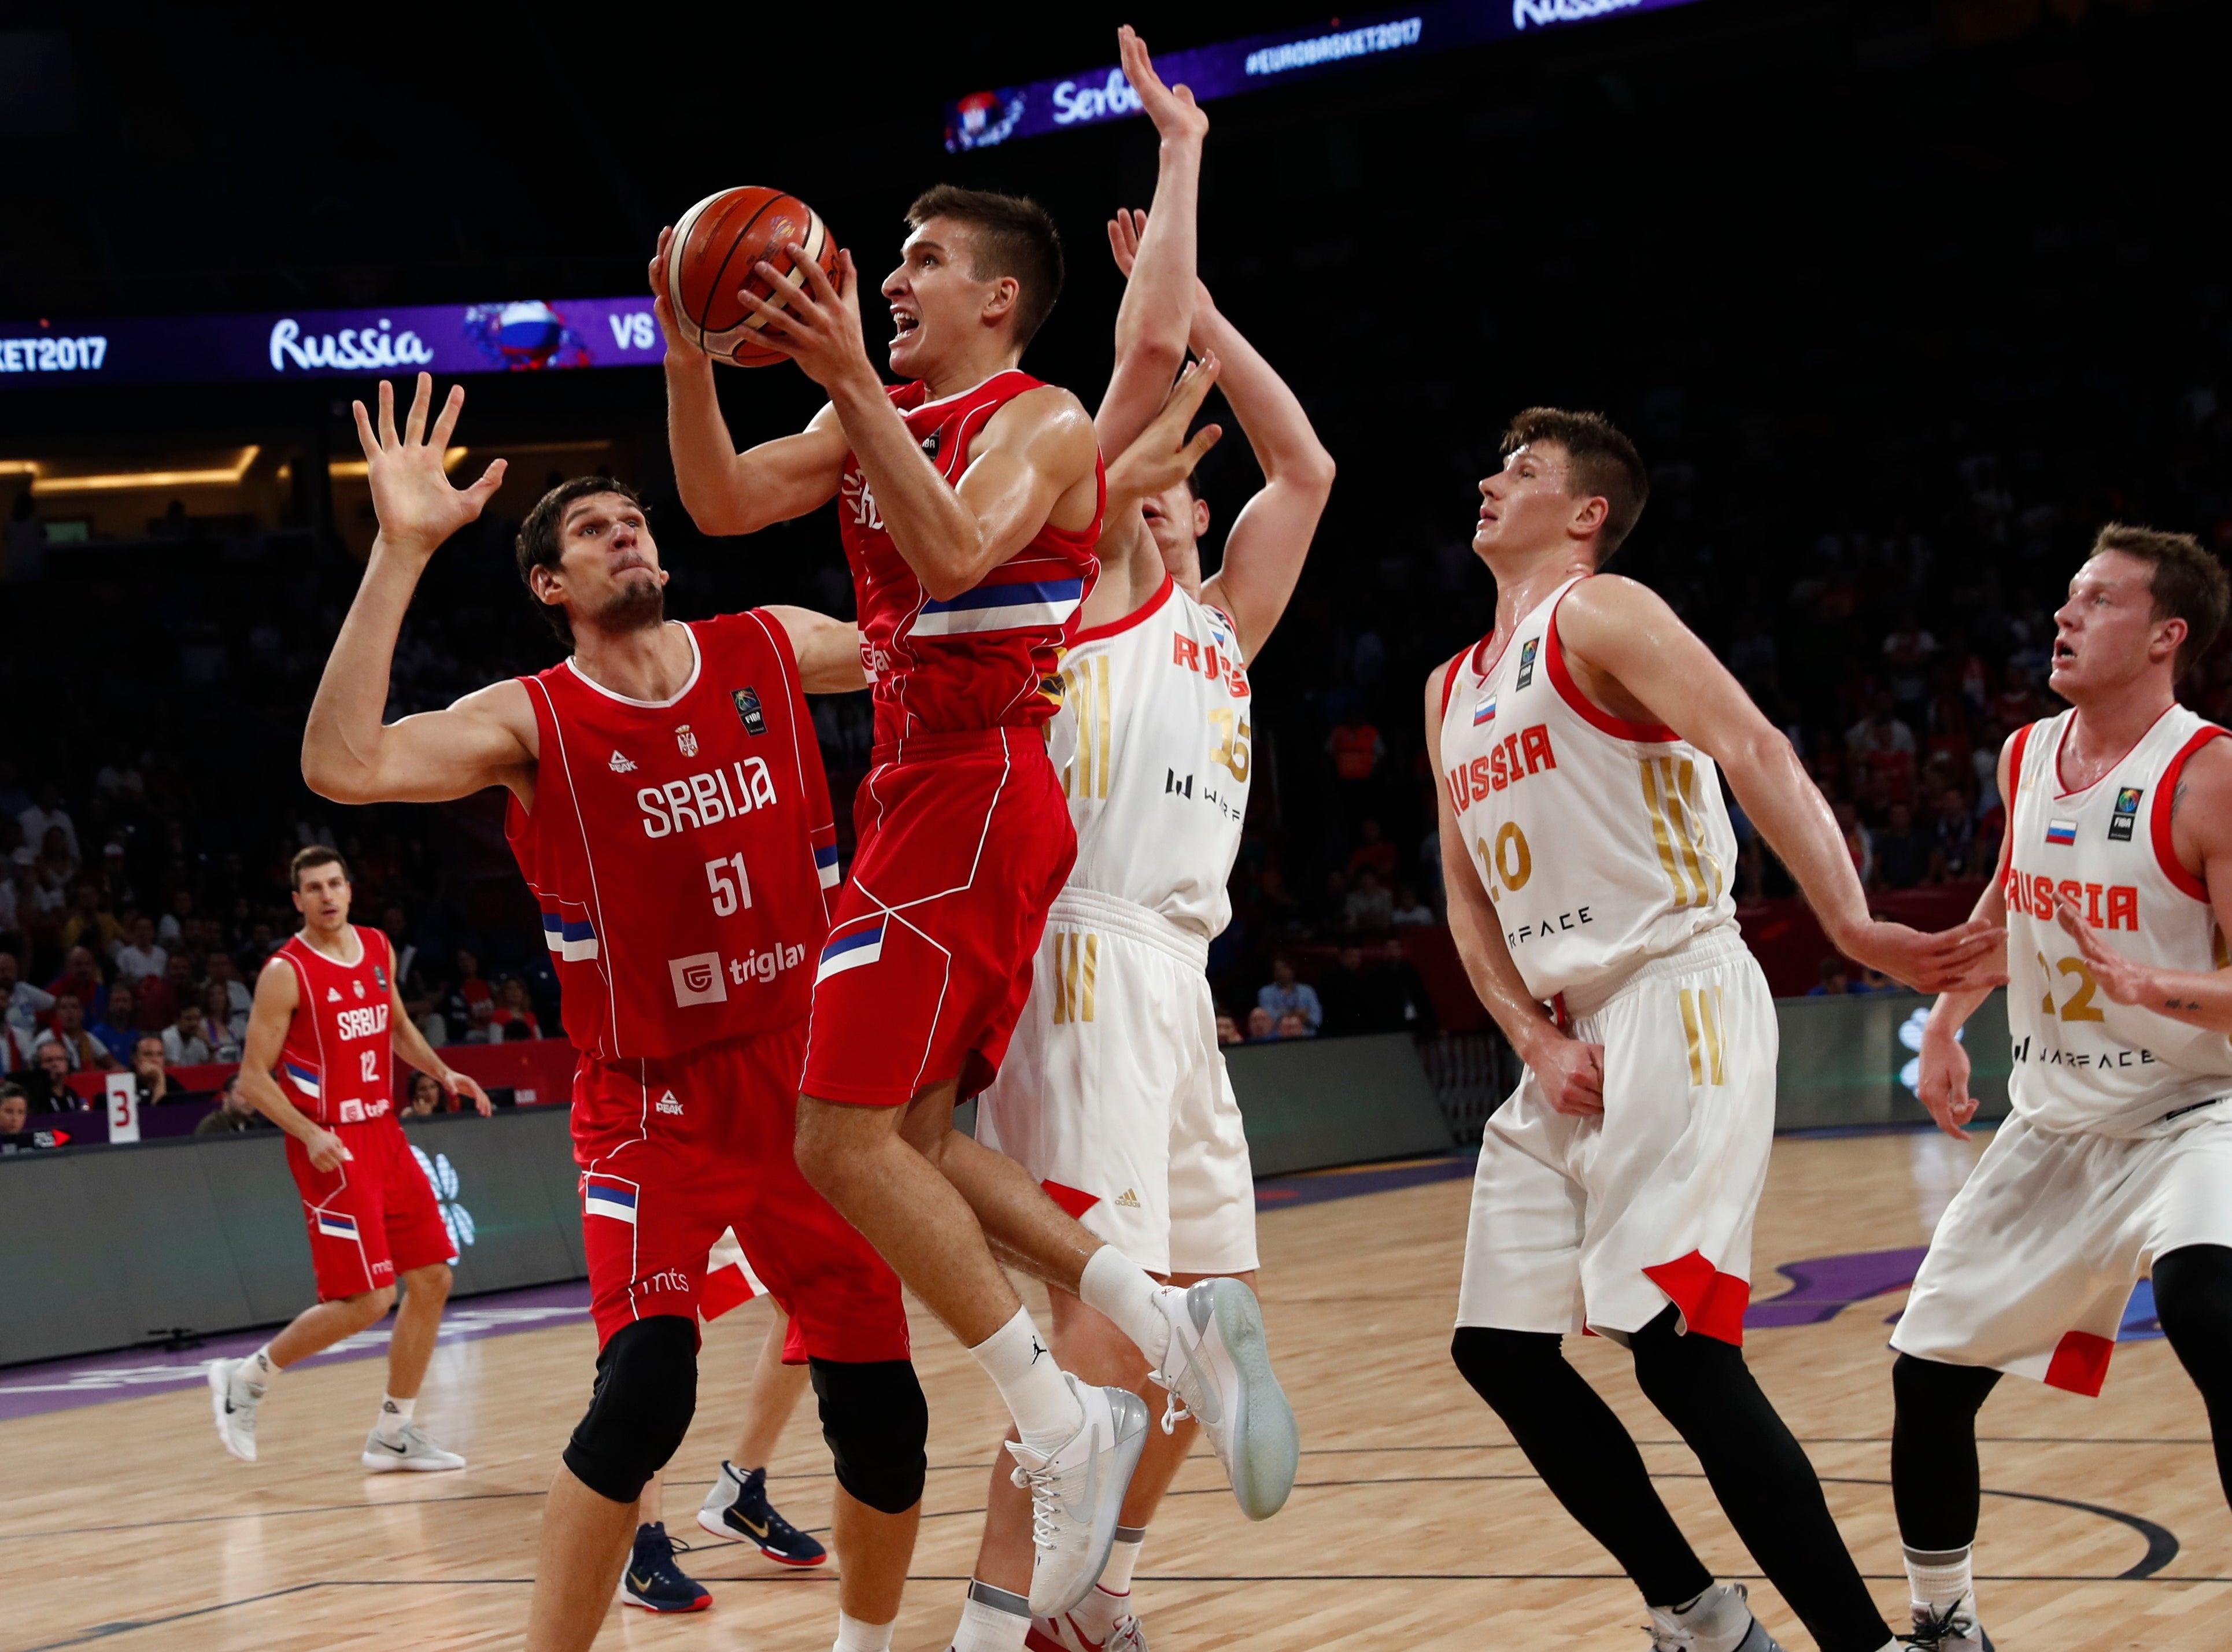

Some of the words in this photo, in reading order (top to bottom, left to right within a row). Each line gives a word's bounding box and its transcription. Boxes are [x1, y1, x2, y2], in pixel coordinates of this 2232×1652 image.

[1246, 17, 1422, 76] #EUROBASKET2017
[269, 318, 434, 371] Russia
[609, 312, 655, 350] VS
[637, 756, 777, 838] SRBIJA
[705, 852, 752, 917] 51
[1477, 821, 1532, 903] 20
[360, 1049, 380, 1083] 12
[113, 1091, 131, 1127] 3
[655, 1102, 684, 1115] PEAK
[1115, 1198, 1141, 1208] adidas
